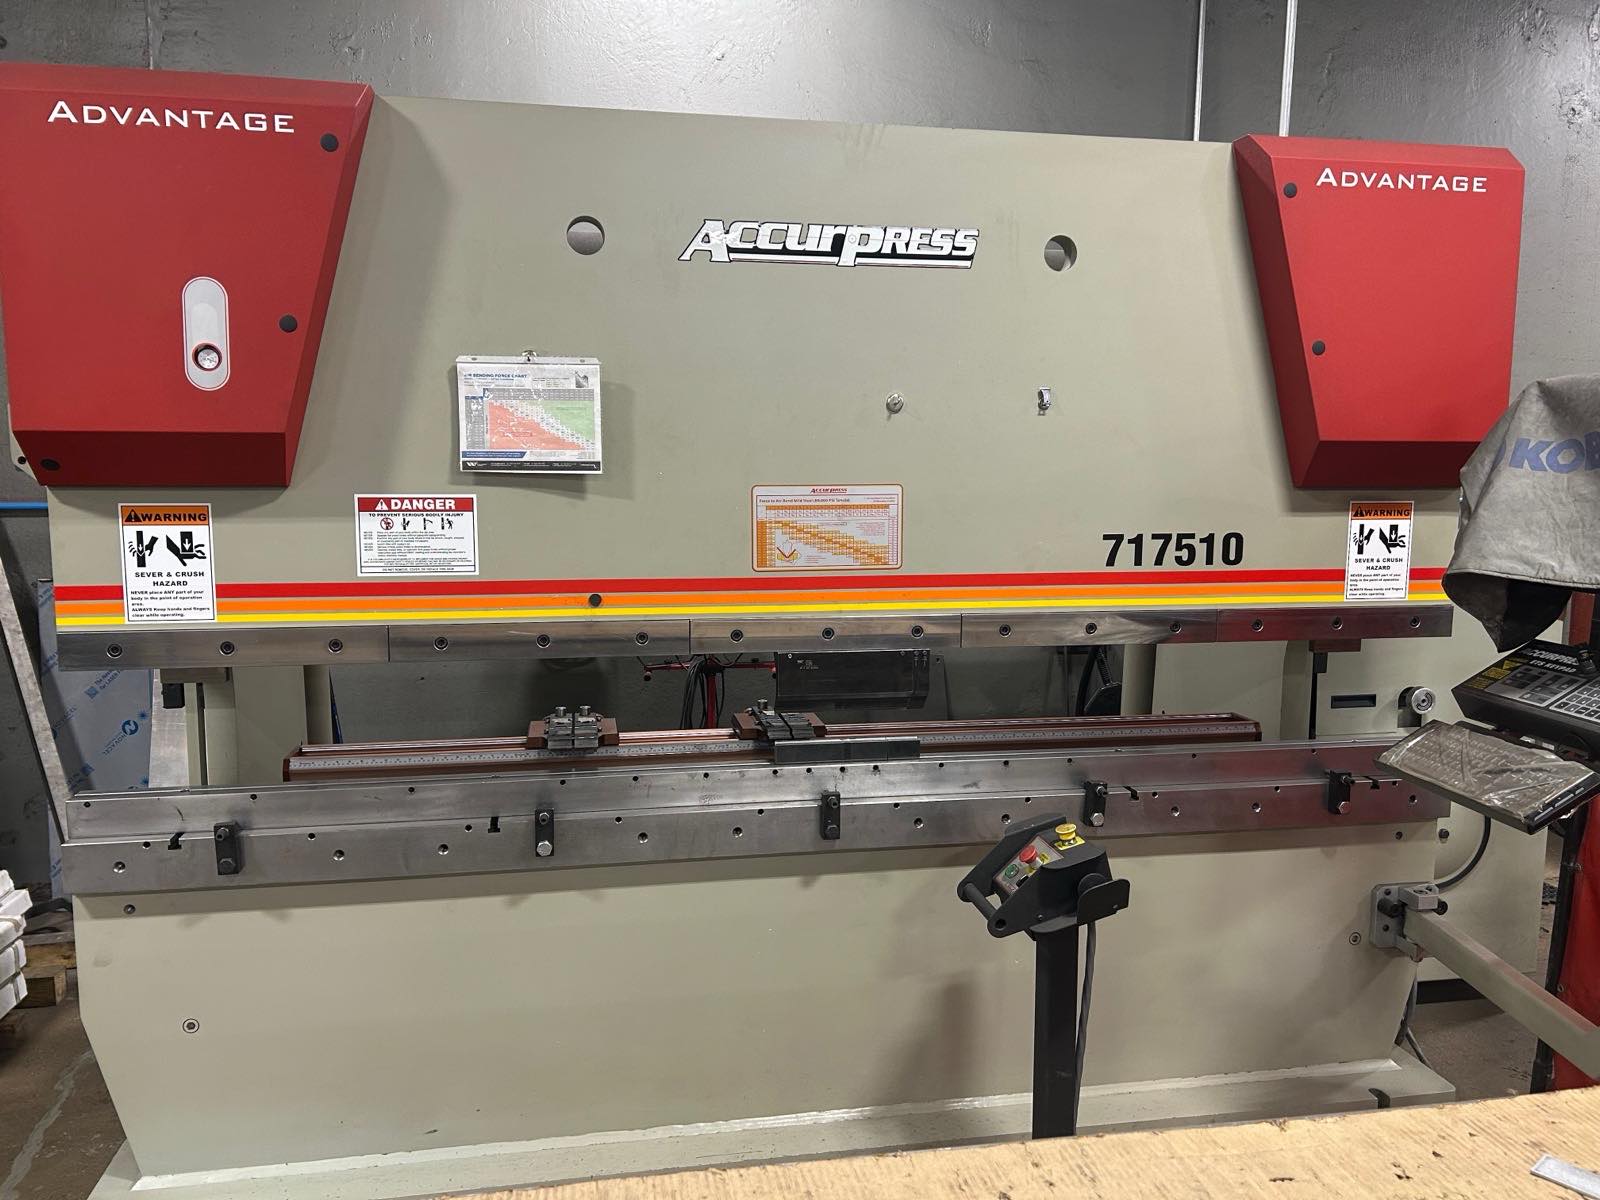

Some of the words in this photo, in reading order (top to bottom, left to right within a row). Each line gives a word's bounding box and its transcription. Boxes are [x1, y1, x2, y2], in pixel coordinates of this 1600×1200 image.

[47, 100, 295, 134] ADVANTAGE
[1316, 168, 1488, 193] ADVANTAGE
[390, 498, 456, 511] DANGER
[1364, 509, 1410, 517] WARNING
[140, 513, 207, 522] WARNING
[1102, 532, 1244, 567] 717510
